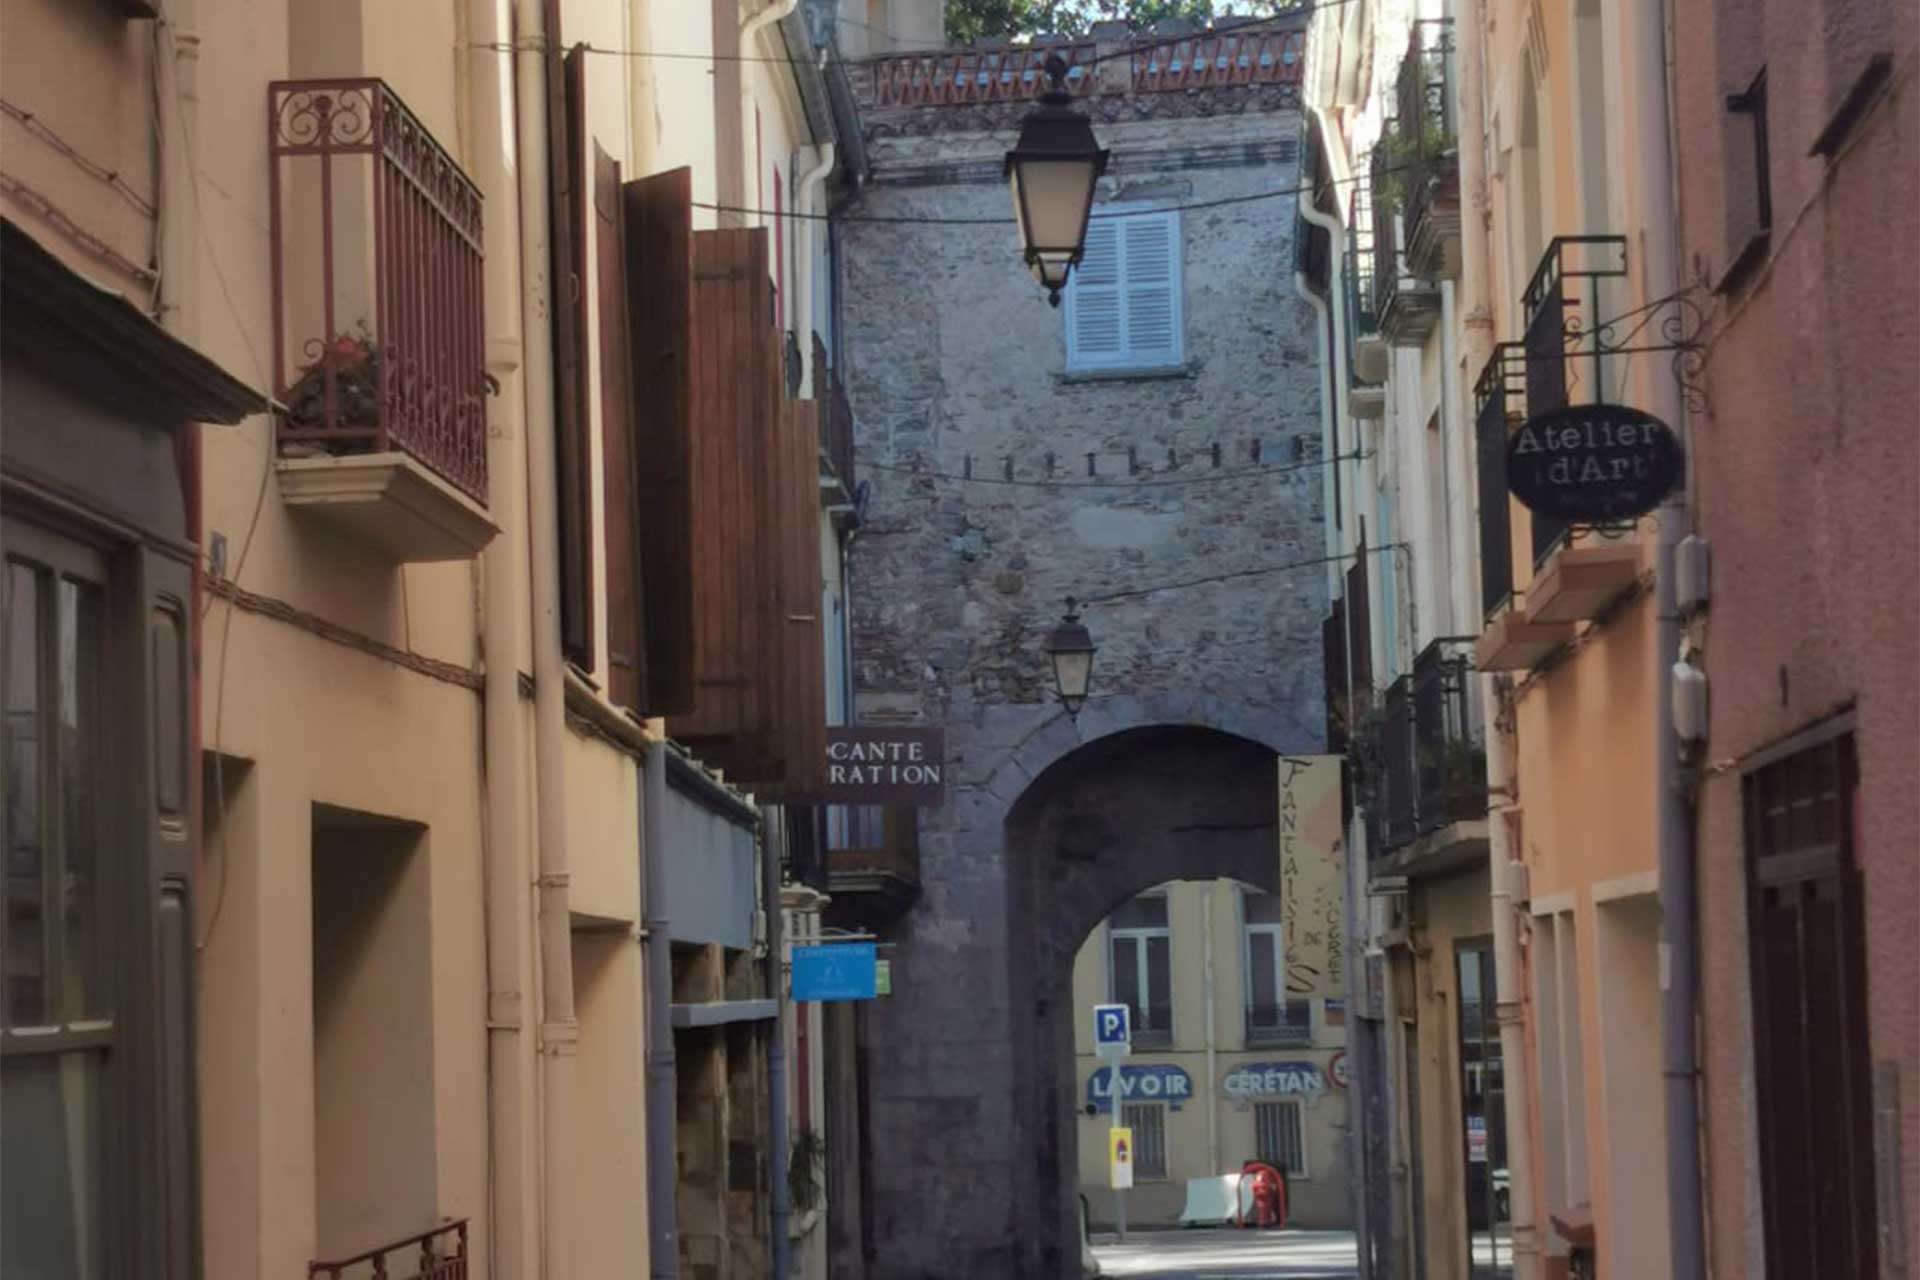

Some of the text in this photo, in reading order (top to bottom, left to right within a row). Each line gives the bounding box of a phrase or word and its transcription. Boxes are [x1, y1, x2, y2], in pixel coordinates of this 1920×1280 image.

[1515, 421, 1659, 454] Atelier
[1549, 455, 1650, 485] d'Art
[825, 742, 923, 761] CANTE
[829, 765, 941, 784] RATION
[1103, 1012, 1120, 1038] P
